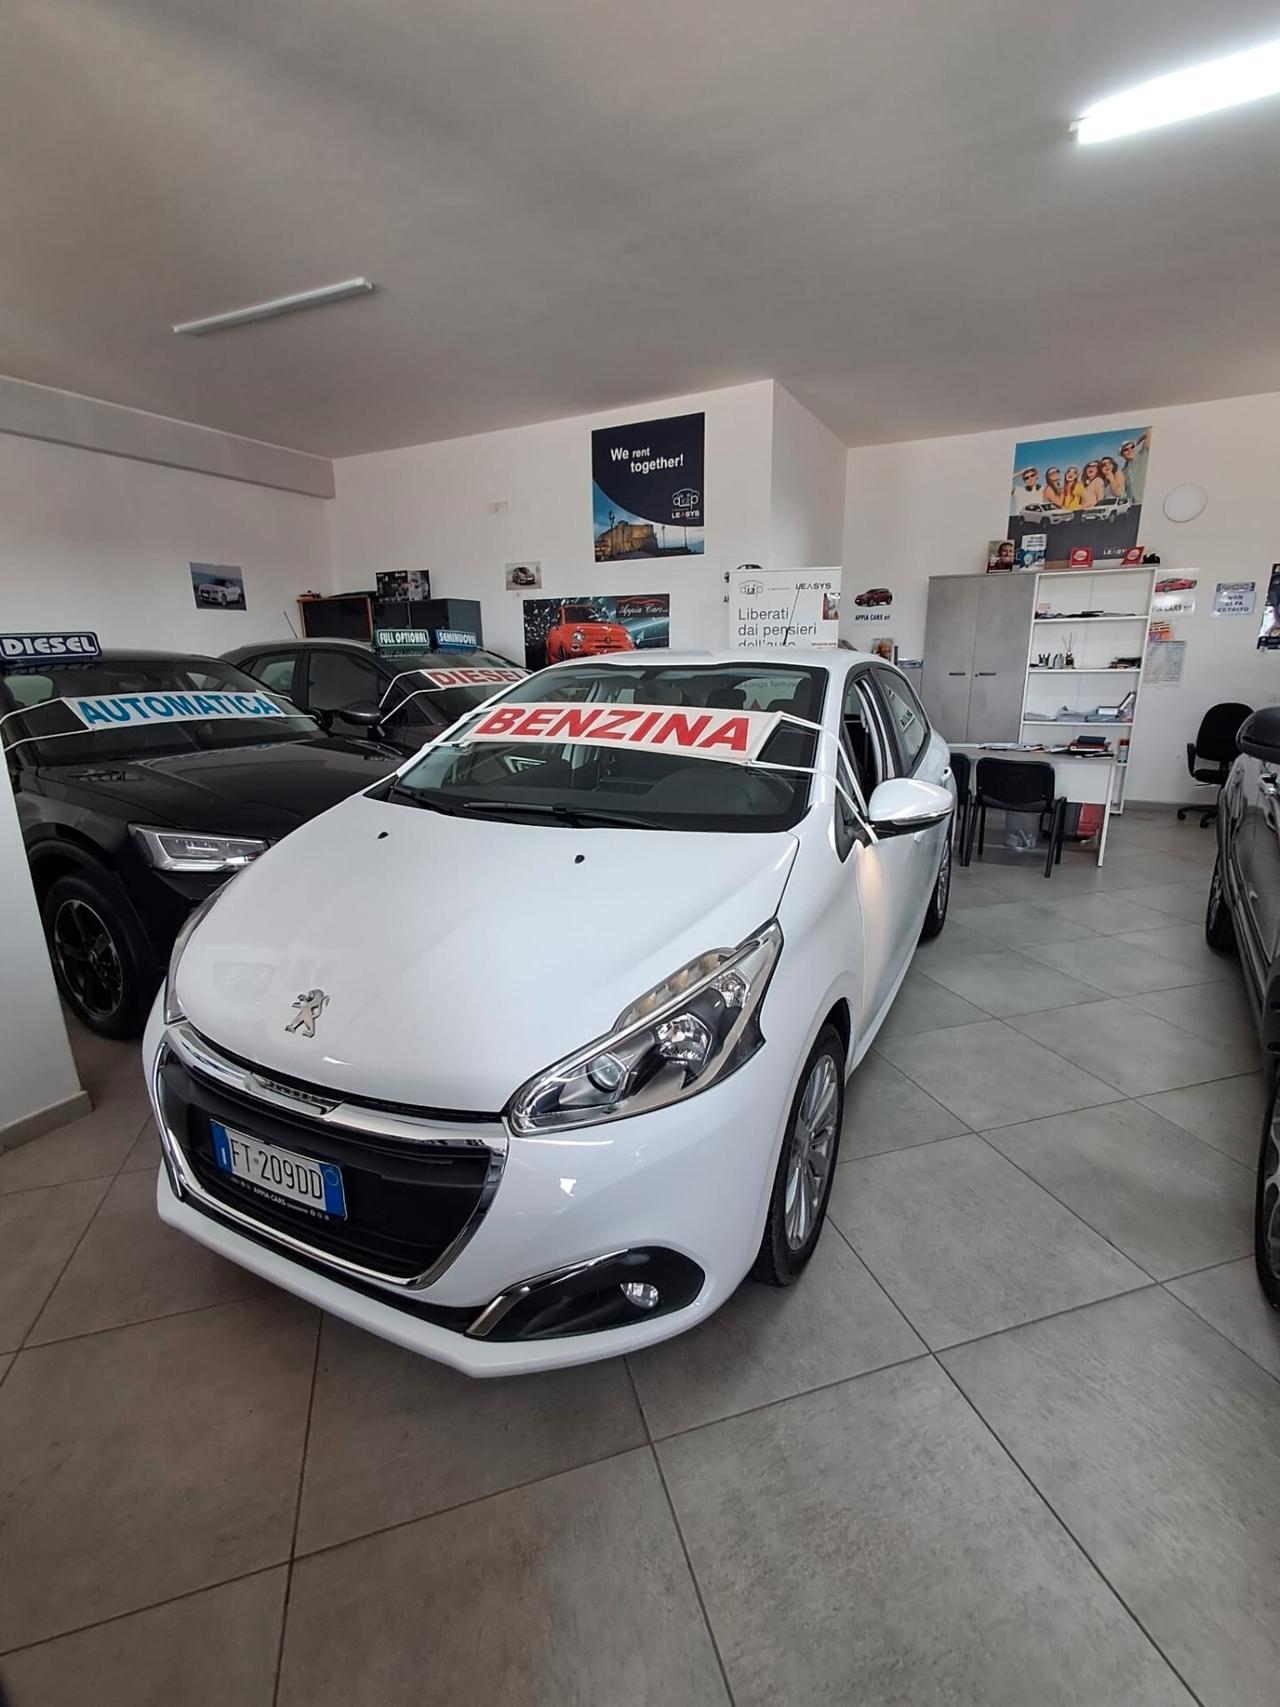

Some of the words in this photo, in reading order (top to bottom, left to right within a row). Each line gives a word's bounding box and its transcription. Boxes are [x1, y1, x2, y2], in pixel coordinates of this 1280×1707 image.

[610, 448, 629, 461] We
[632, 448, 650, 458] rent
[630, 454, 684, 474] together!
[671, 510, 700, 519] LEASYS
[795, 582, 832, 590] LEASYS
[738, 607, 789, 621] Liberati
[738, 624, 758, 636] dai
[763, 622, 817, 638] pensieri
[379, 632, 395, 643] FULL
[395, 632, 428, 644] OPTIONAL
[439, 633, 477, 645] SEMINUOVA
[1, 637, 95, 656] DIESEL
[78, 695, 280, 725] AUTOMATICA
[474, 708, 749, 751] BENZINA
[230, 1138, 251, 1173] FT
[258, 1150, 323, 1200] 209DD
